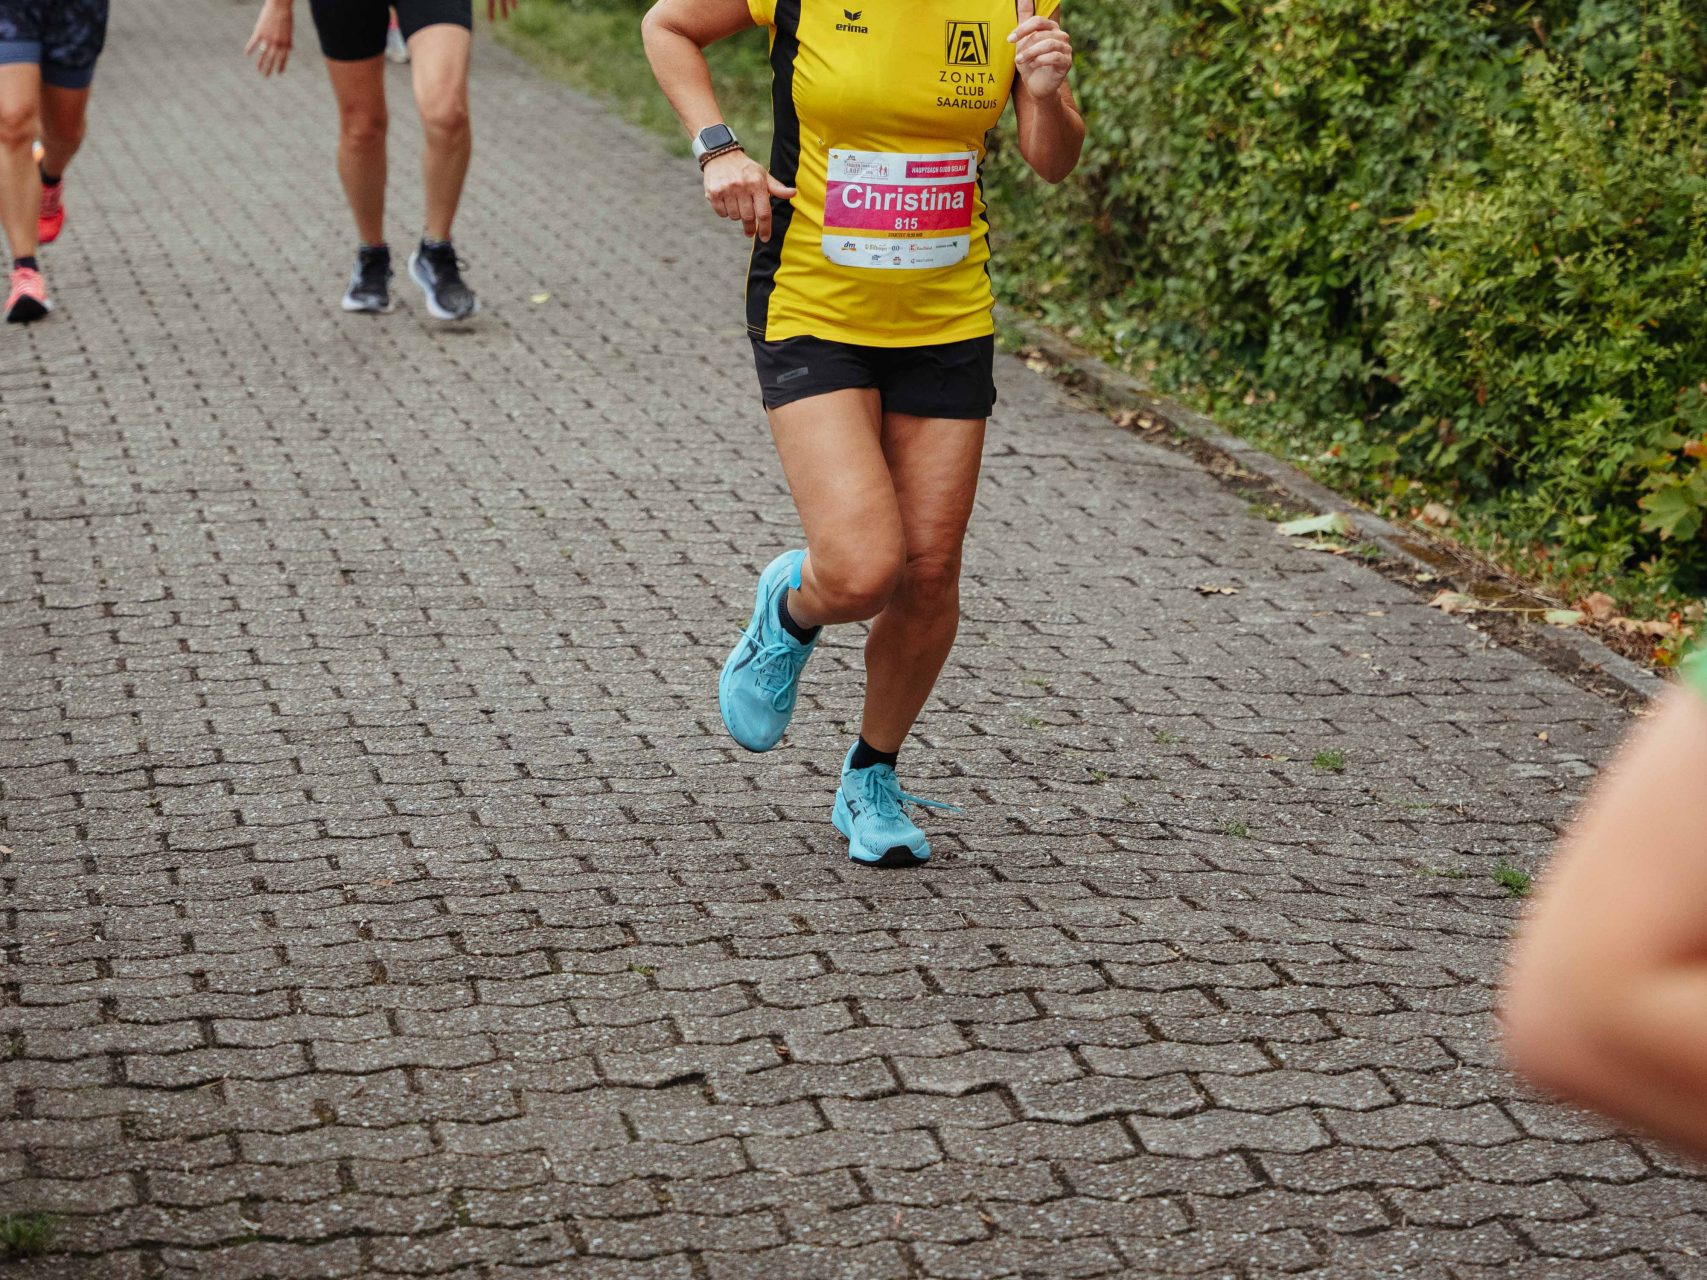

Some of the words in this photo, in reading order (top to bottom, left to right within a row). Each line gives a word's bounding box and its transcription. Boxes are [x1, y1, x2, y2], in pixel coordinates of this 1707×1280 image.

[835, 23, 868, 34] erima
[939, 71, 995, 84] ZONTA
[956, 85, 984, 96] CLUB
[936, 96, 997, 110] SAARLOUIS
[841, 184, 965, 212] Christina
[894, 217, 919, 231] 815
